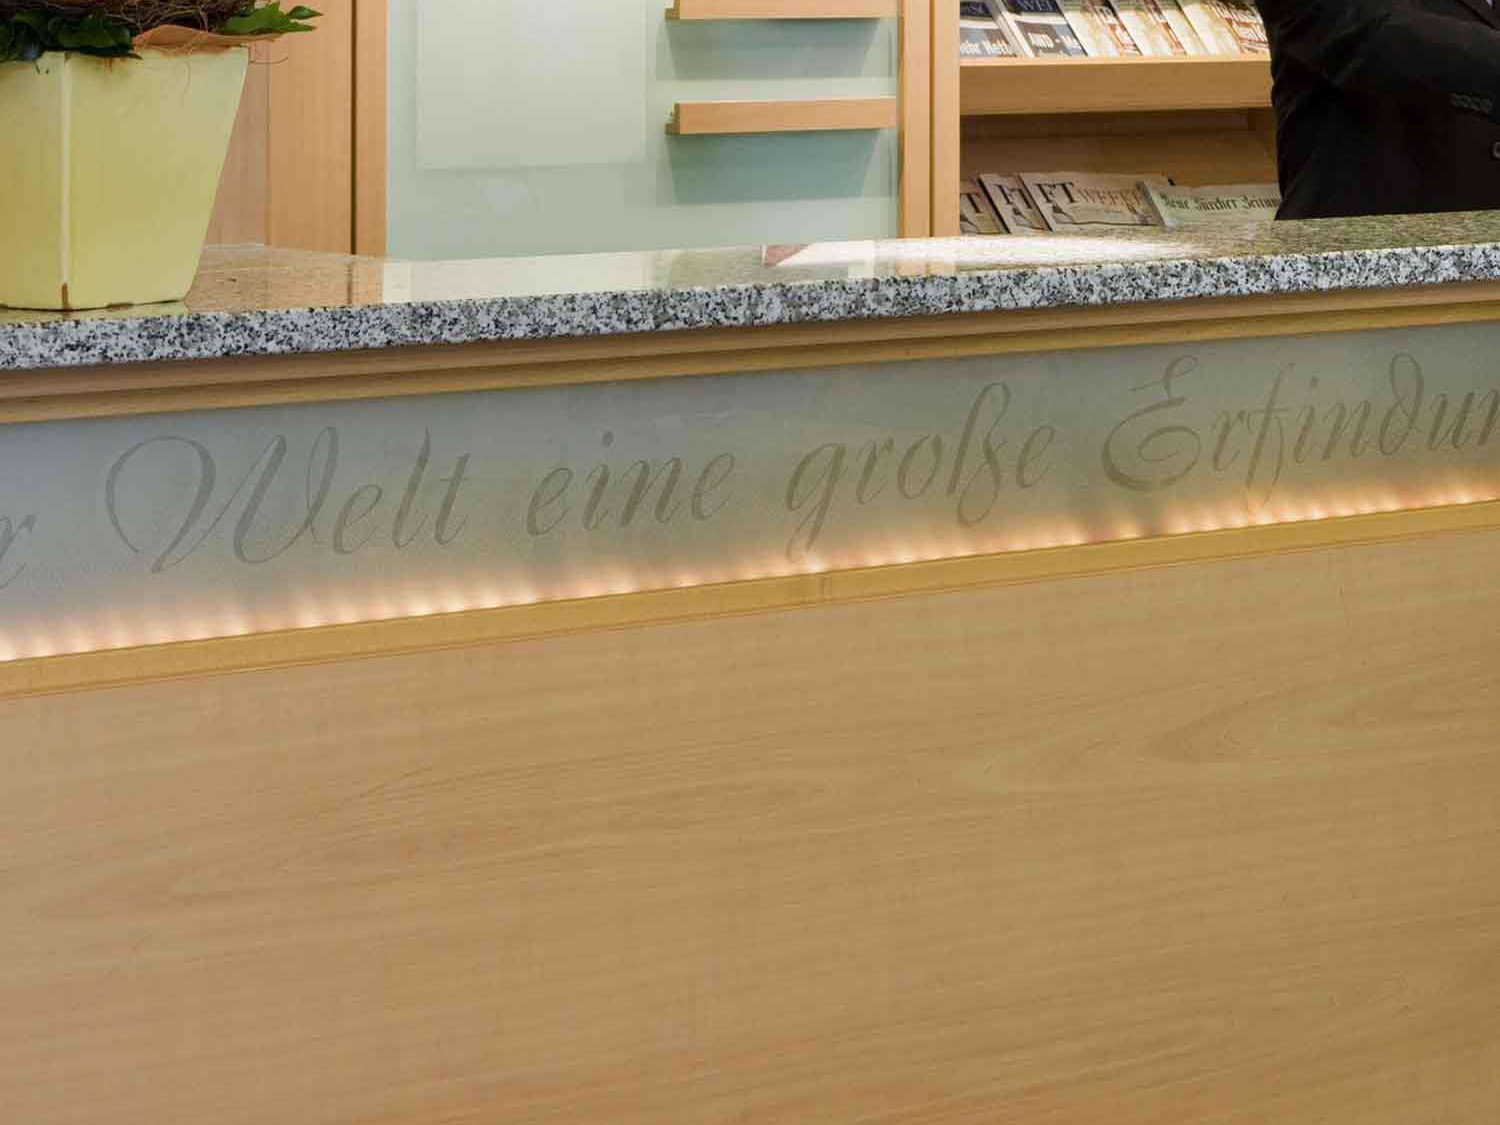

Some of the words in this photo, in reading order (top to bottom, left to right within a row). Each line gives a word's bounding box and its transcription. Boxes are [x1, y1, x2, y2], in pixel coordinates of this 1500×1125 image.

[1033, 181, 1076, 205] FT
[104, 426, 471, 573] Welt
[525, 429, 737, 538] eine
[784, 380, 1056, 564] große
